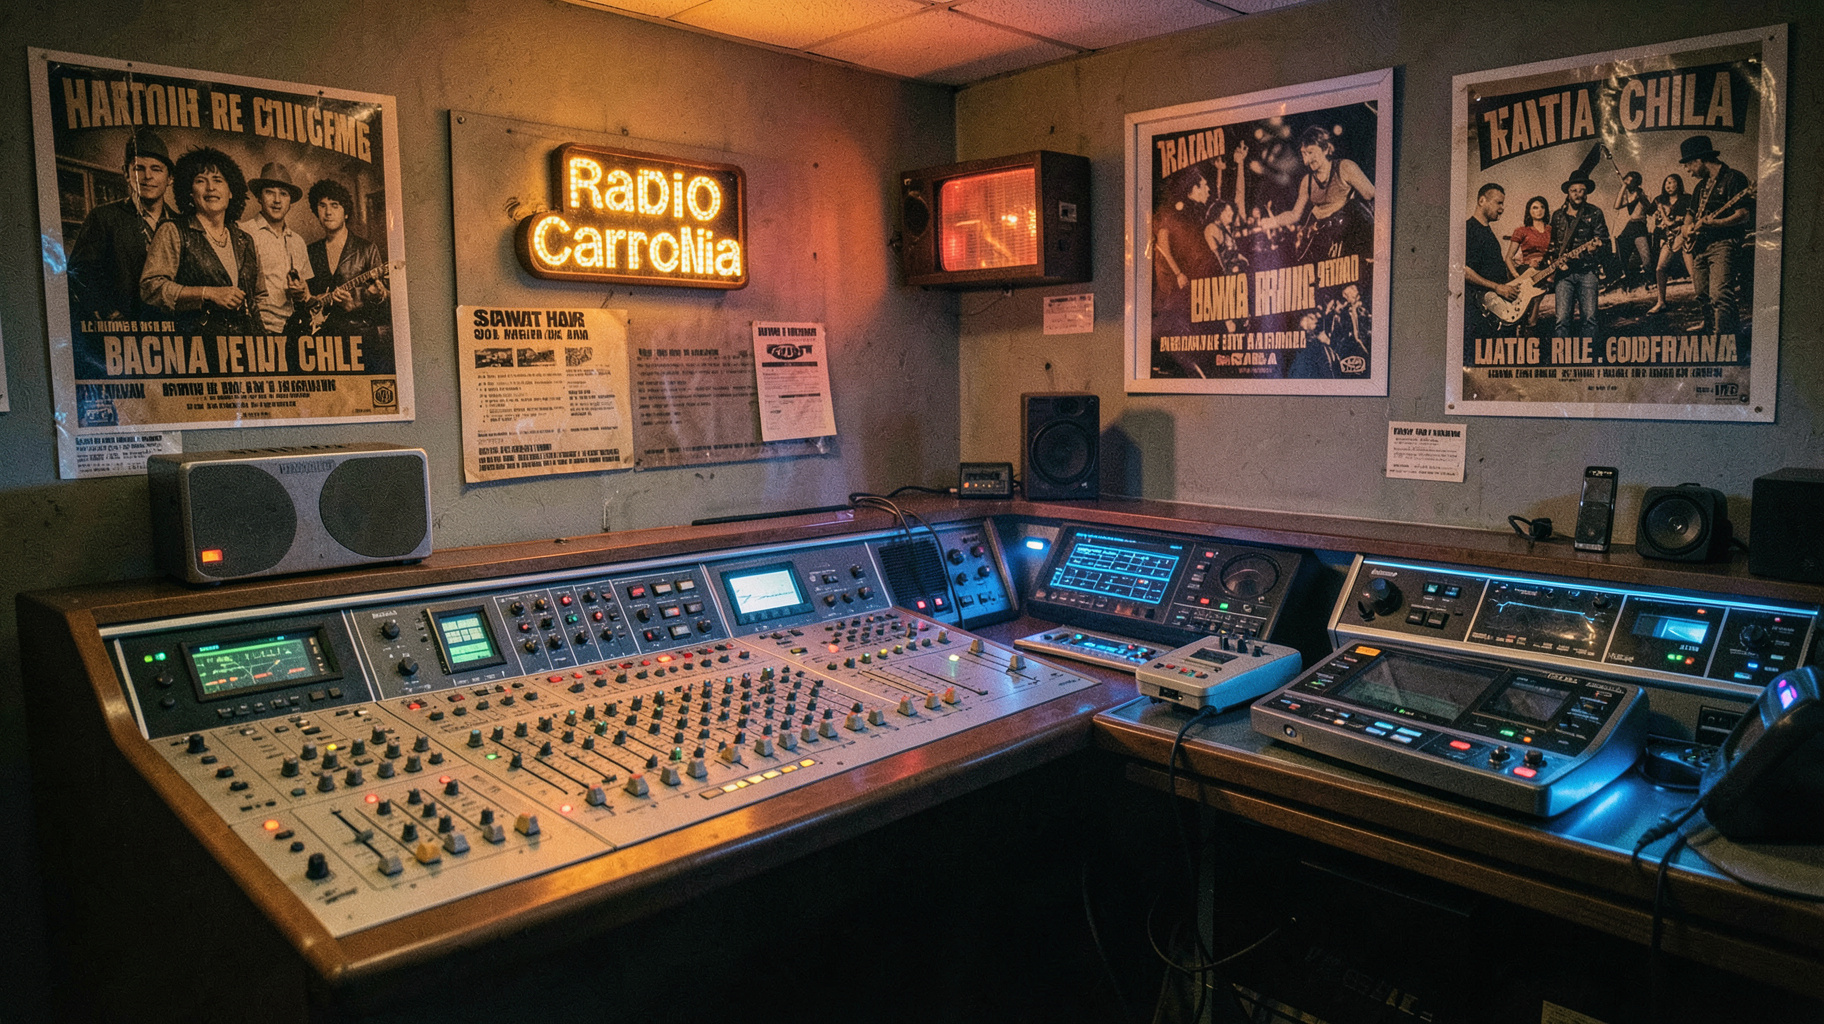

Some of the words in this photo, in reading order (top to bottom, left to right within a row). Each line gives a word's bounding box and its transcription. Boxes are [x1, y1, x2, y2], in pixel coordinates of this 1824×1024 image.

[211, 91, 243, 132] RE
[1619, 71, 1734, 131] CHILA
[298, 335, 365, 372] CHLE
